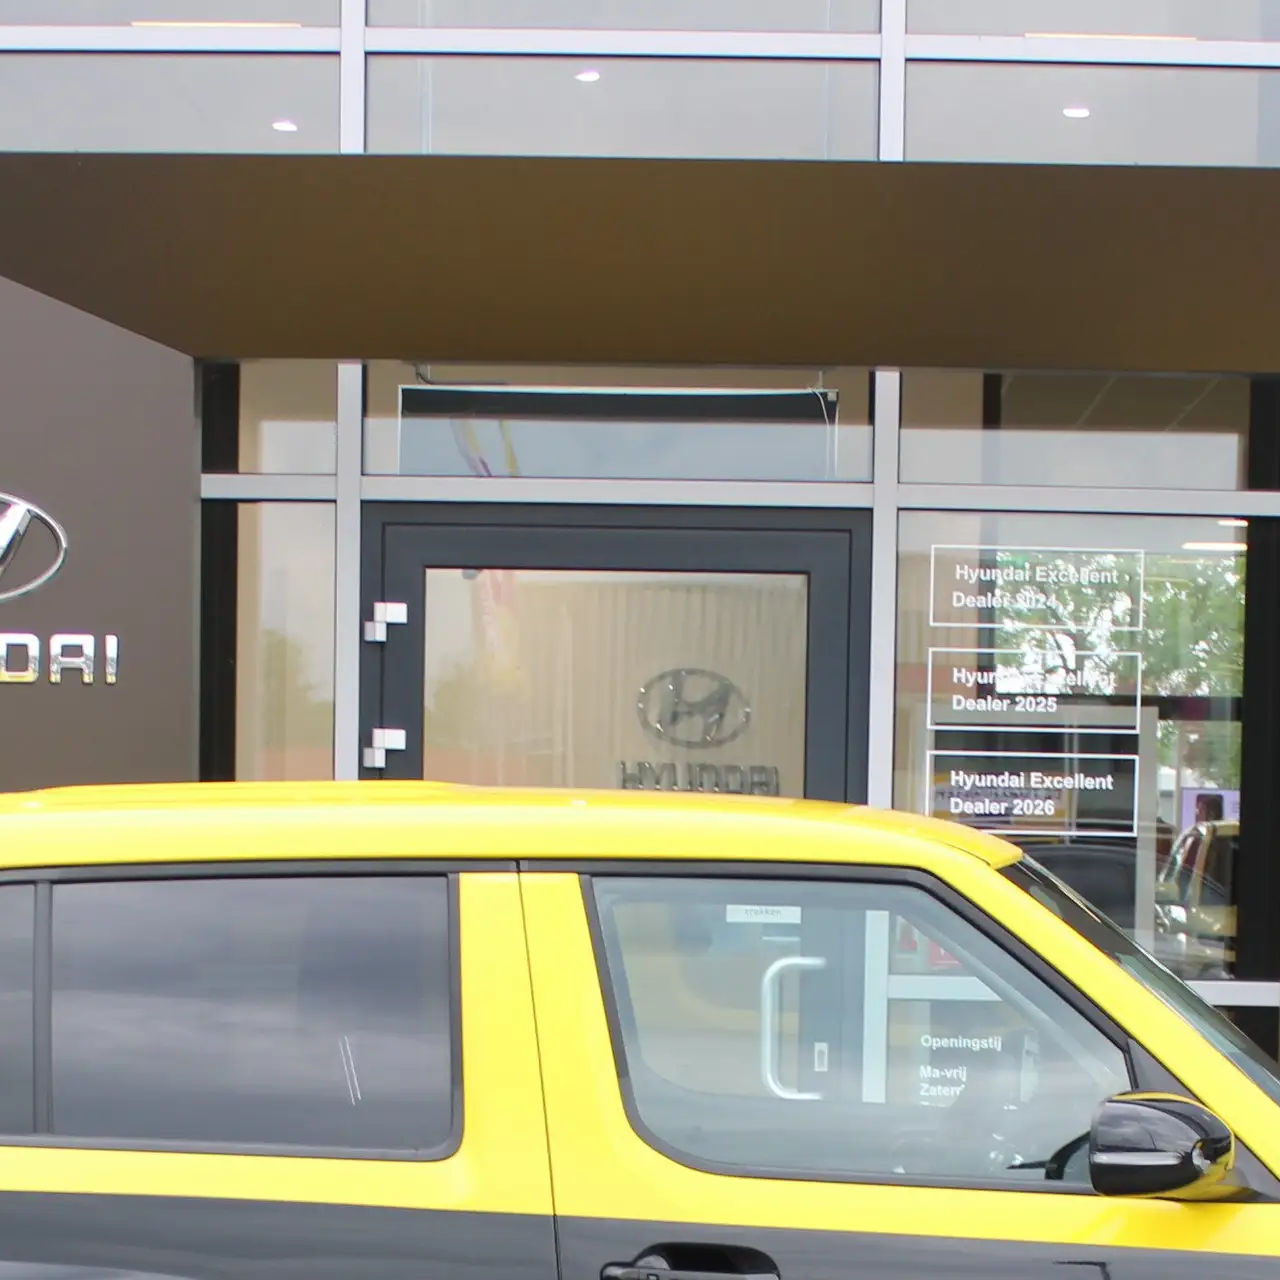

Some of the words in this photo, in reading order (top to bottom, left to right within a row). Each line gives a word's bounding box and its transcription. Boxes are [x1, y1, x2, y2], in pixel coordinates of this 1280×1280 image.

[955, 562, 1030, 583] Hyundai
[1035, 564, 1118, 584] Excellent
[952, 591, 1008, 608] Dealer
[952, 666, 1028, 687] Hyun
[952, 694, 1010, 712] Dealer
[1014, 696, 1058, 713] 2025
[619, 759, 779, 798] HYUNDAI
[950, 770, 1024, 790] Hyundai
[1030, 772, 1114, 790] Excellent
[950, 797, 1008, 815] Dealer
[1012, 799, 1055, 816] 2026
[744, 907, 782, 917] trekken
[920, 1034, 1002, 1052] Openingstij
[920, 1083, 966, 1096] Zater
